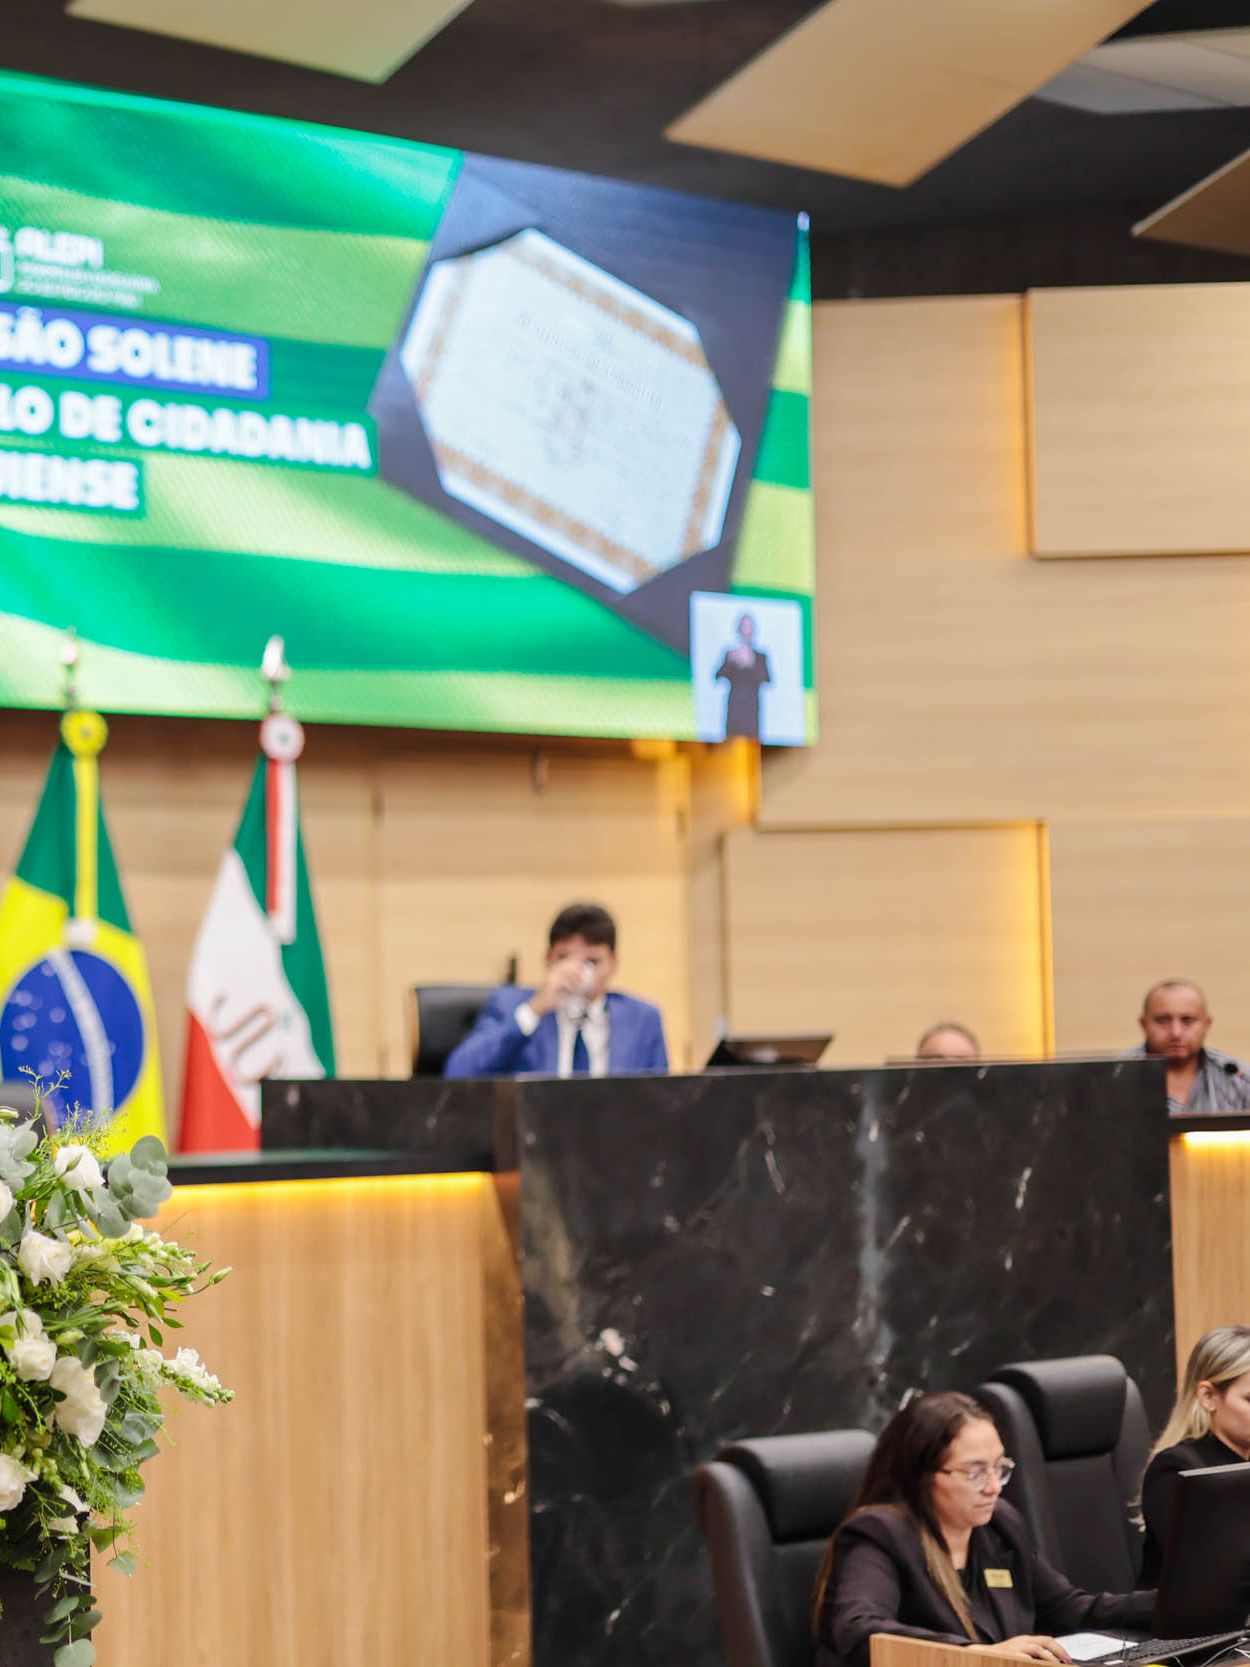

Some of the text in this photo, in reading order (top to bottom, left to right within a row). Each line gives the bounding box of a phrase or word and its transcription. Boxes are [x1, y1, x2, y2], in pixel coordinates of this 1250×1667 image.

[86, 324, 258, 391] SOLENE
[59, 390, 123, 442] DE
[126, 399, 374, 470] CIDADANIA
